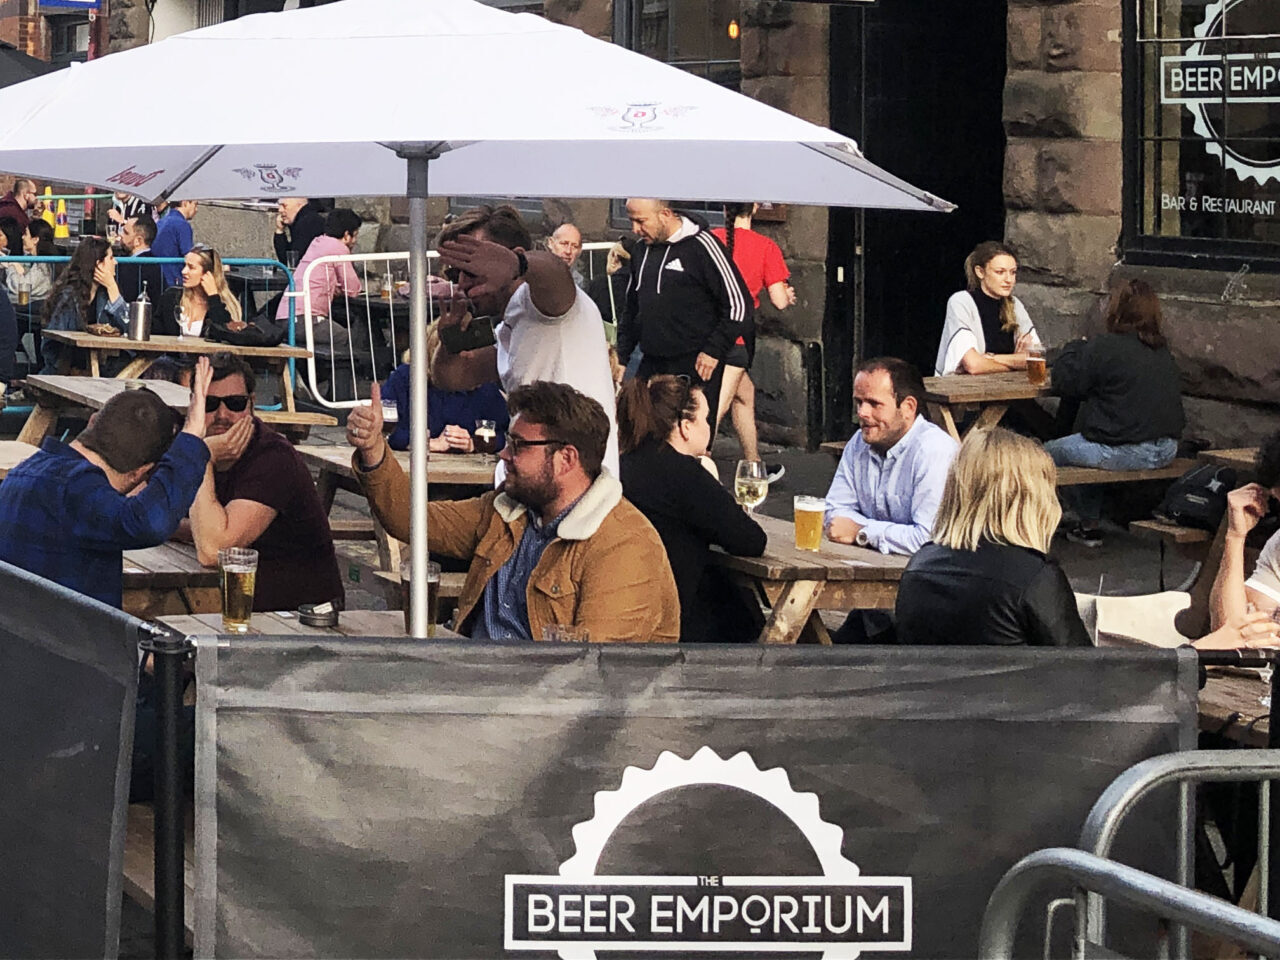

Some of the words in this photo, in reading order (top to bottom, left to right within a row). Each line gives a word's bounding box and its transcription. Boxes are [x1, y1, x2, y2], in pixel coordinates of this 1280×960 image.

[1171, 67, 1223, 91] BEER
[1231, 66, 1280, 90] EMP
[1189, 197, 1198, 211] &
[698, 875, 719, 887] THE
[528, 894, 636, 933] BEER
[651, 894, 889, 934] EMPORIUM
